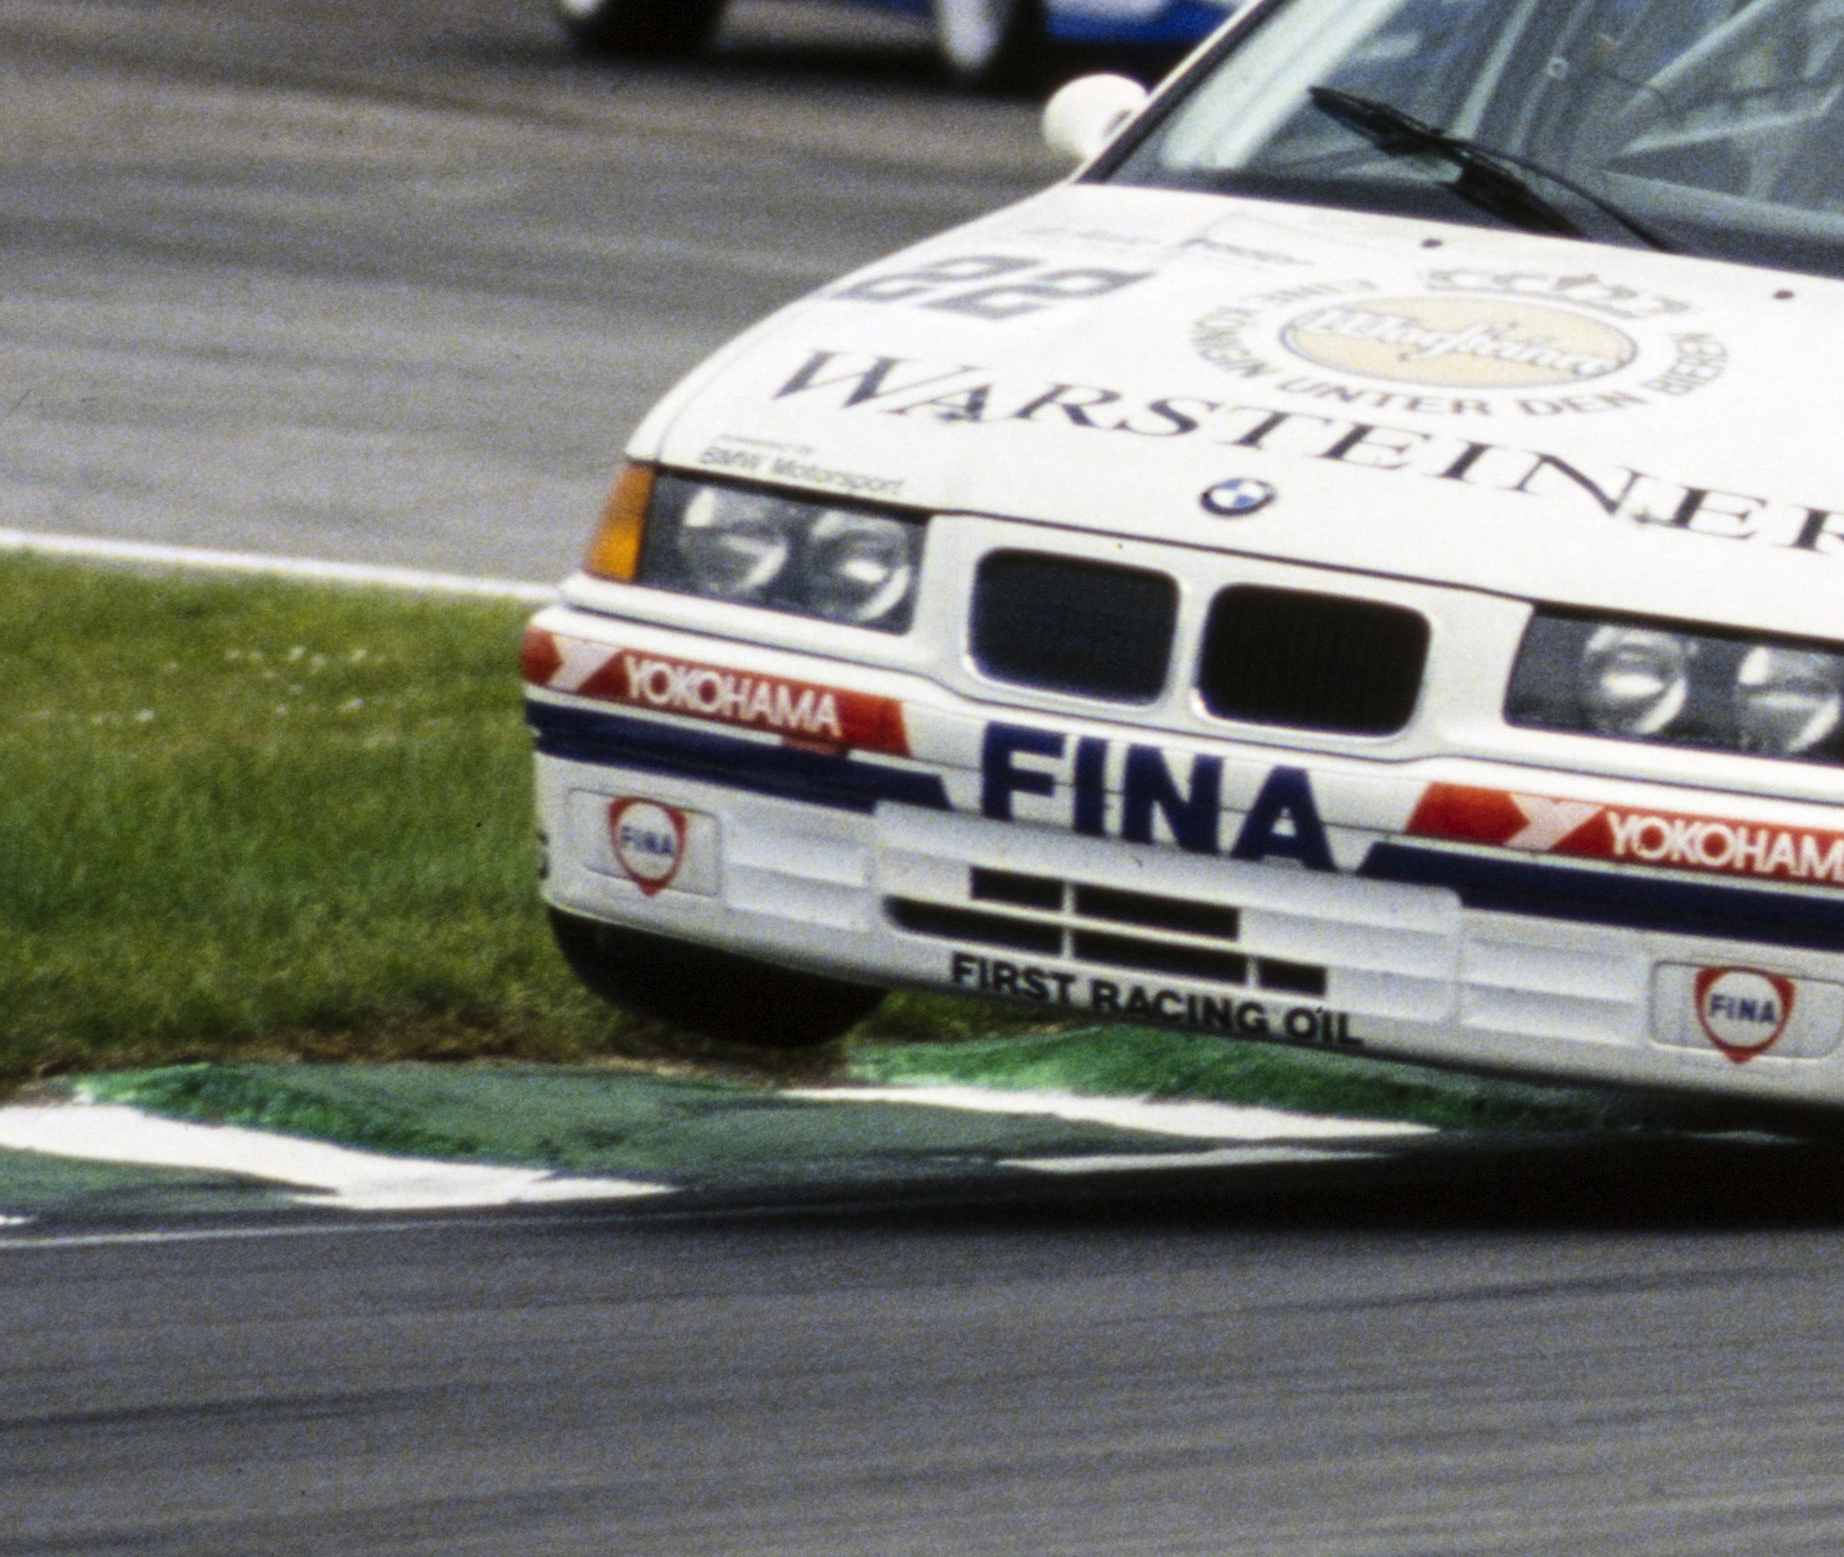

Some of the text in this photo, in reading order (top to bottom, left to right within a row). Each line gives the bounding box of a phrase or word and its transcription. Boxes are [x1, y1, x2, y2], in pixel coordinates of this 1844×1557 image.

[833, 255, 1158, 321] 22
[1276, 376, 1492, 417] UNTER
[1515, 389, 1650, 418] DEN
[768, 456, 905, 494] Motorsport
[623, 653, 842, 738] YOKOHAMA
[980, 720, 1342, 874] FINA
[620, 824, 676, 857] FINA
[950, 951, 1364, 1045] FIRST RACING OIL
[1708, 991, 1779, 1027] FINA
